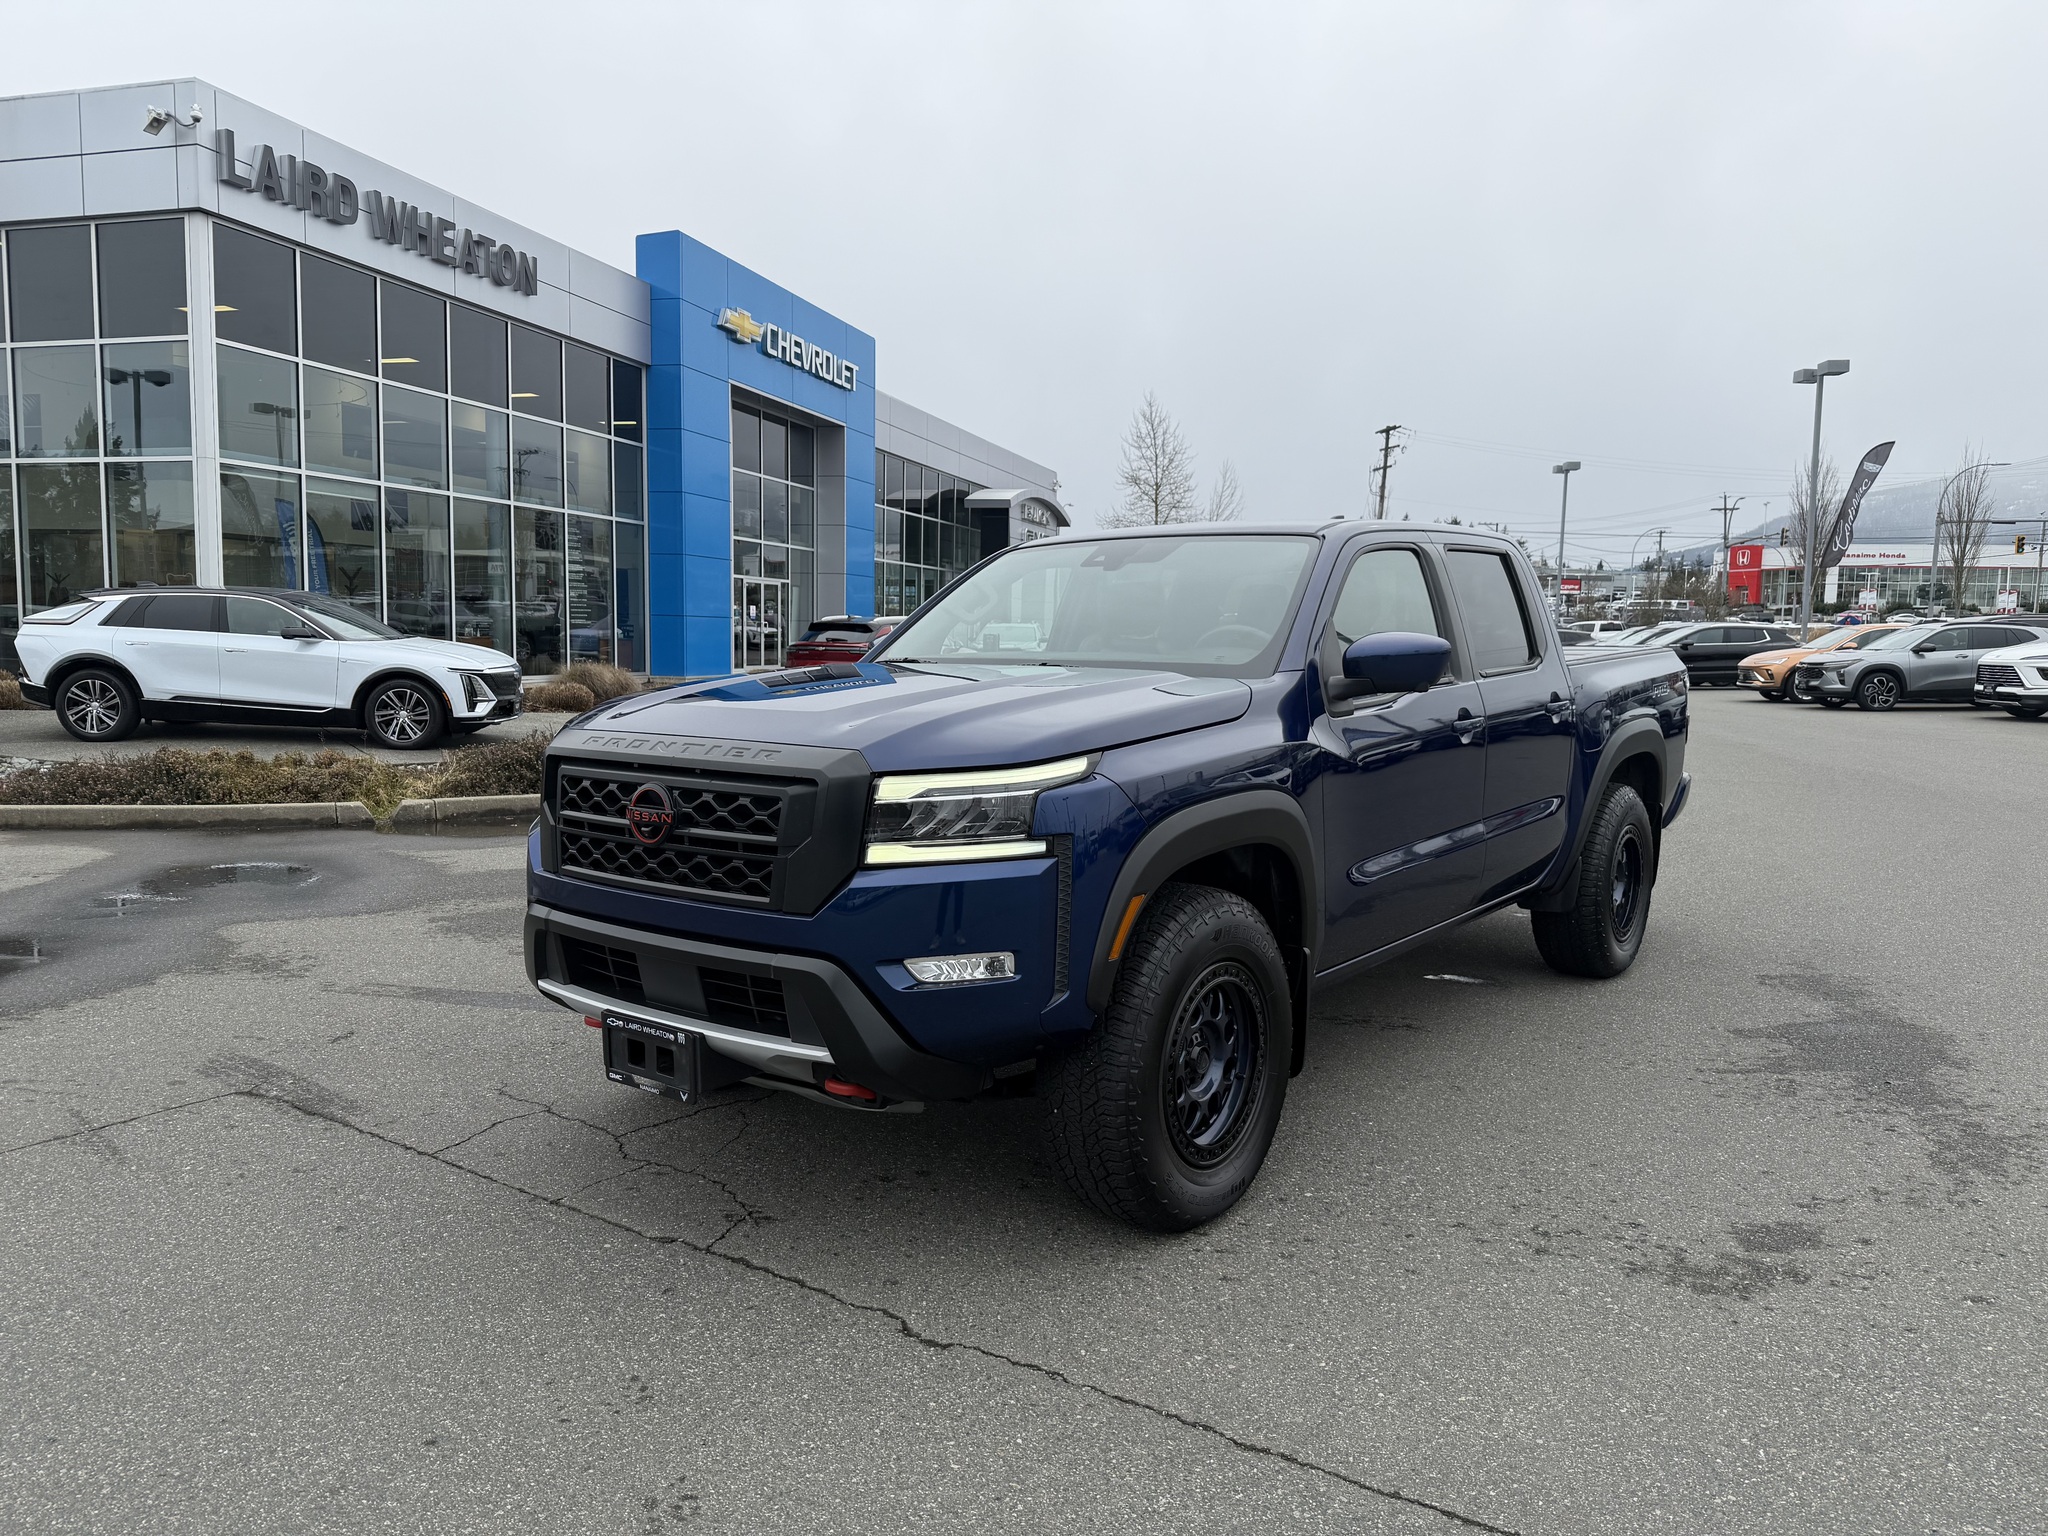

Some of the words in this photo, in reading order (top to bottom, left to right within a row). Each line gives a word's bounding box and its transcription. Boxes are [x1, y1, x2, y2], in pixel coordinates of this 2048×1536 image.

[217, 128, 358, 225] LAIRD
[366, 189, 538, 296] WHEATON
[763, 322, 859, 392] CHEVROLET
[582, 736, 782, 761] FRONTIER
[626, 807, 673, 824] NISSAN
[624, 1021, 643, 1031] LAIRD
[609, 1072, 623, 1080] GMC
